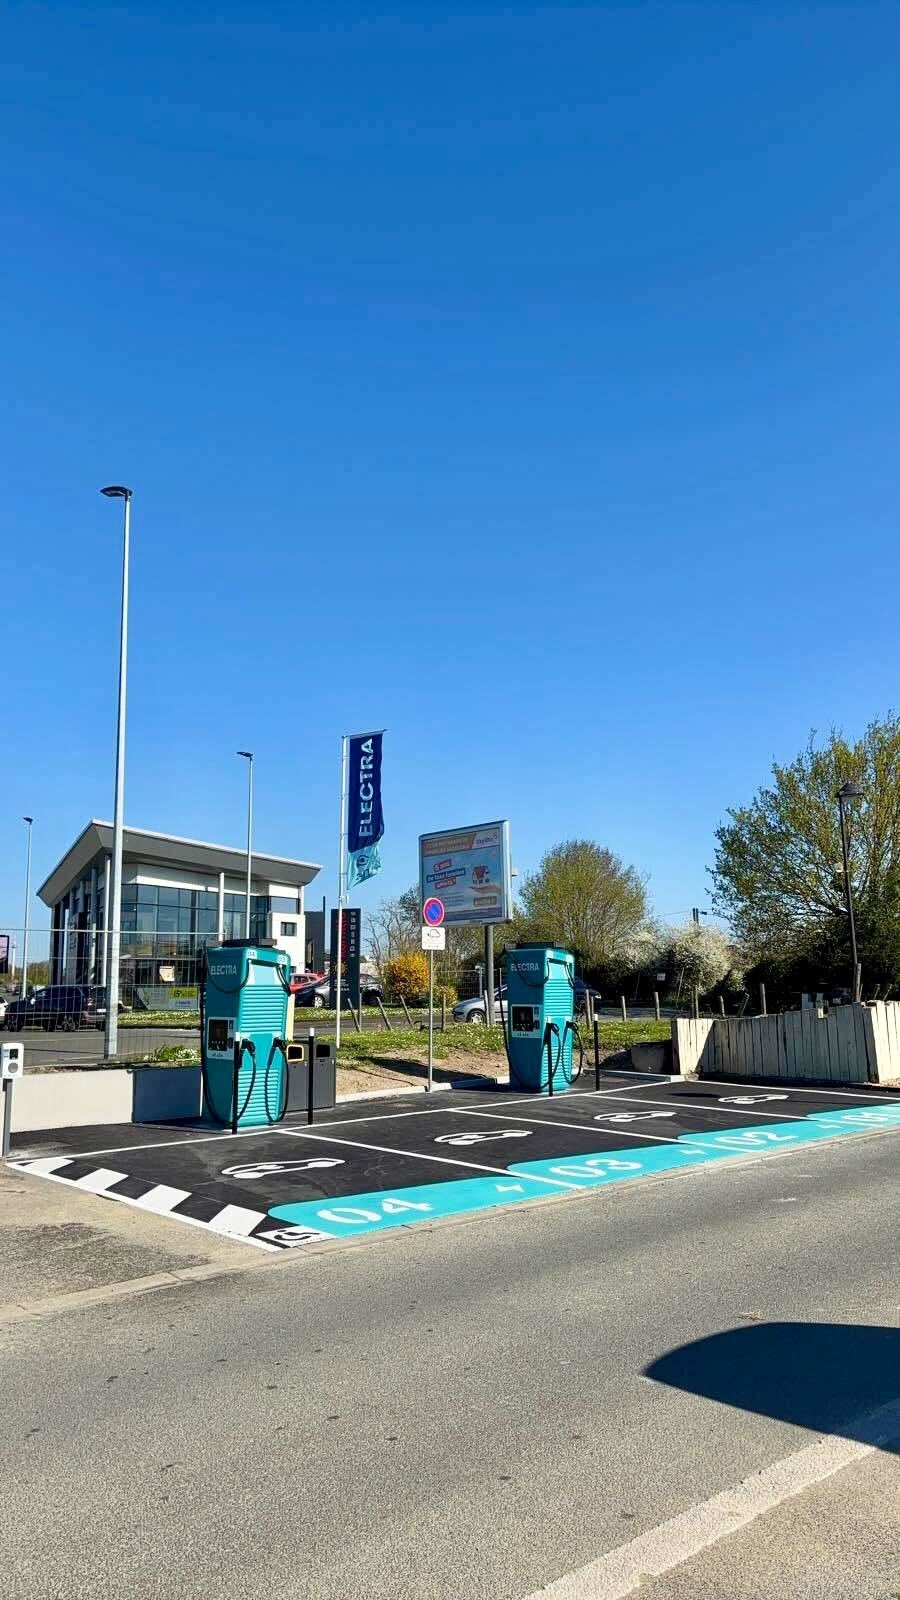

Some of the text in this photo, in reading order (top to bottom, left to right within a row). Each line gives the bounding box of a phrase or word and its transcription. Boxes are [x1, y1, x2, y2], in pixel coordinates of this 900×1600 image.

[359, 738, 374, 837] ELECTRA
[210, 965, 237, 975] ELECTRA
[510, 963, 540, 972] ELECTRA
[714, 1131, 799, 1146] 02
[549, 1158, 643, 1178] 03
[316, 1197, 434, 1224] 04
